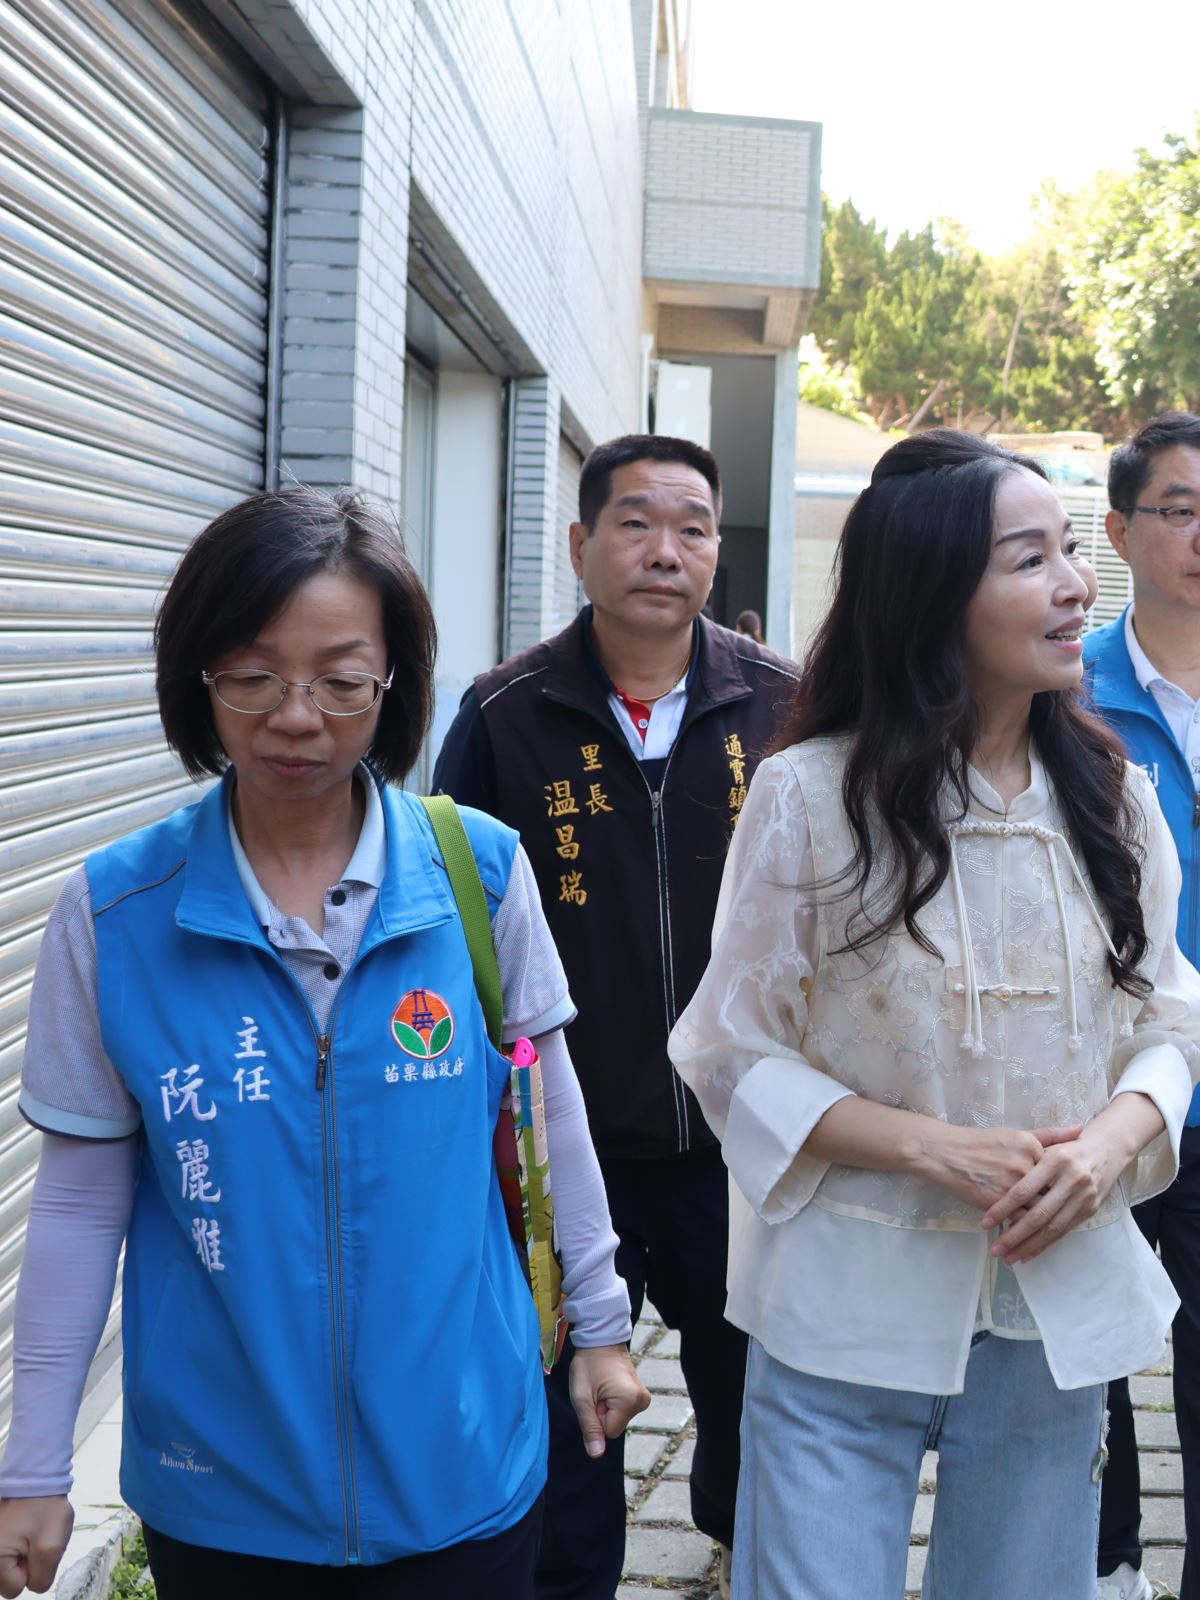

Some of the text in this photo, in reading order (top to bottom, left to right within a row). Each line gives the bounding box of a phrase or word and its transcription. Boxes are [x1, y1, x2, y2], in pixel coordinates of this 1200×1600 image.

[580, 744, 614, 816] 里長
[232, 1016, 272, 1103] 主任
[384, 1057, 465, 1083] 苗栗縣政府
[159, 1064, 226, 1273] 阮麗雅
